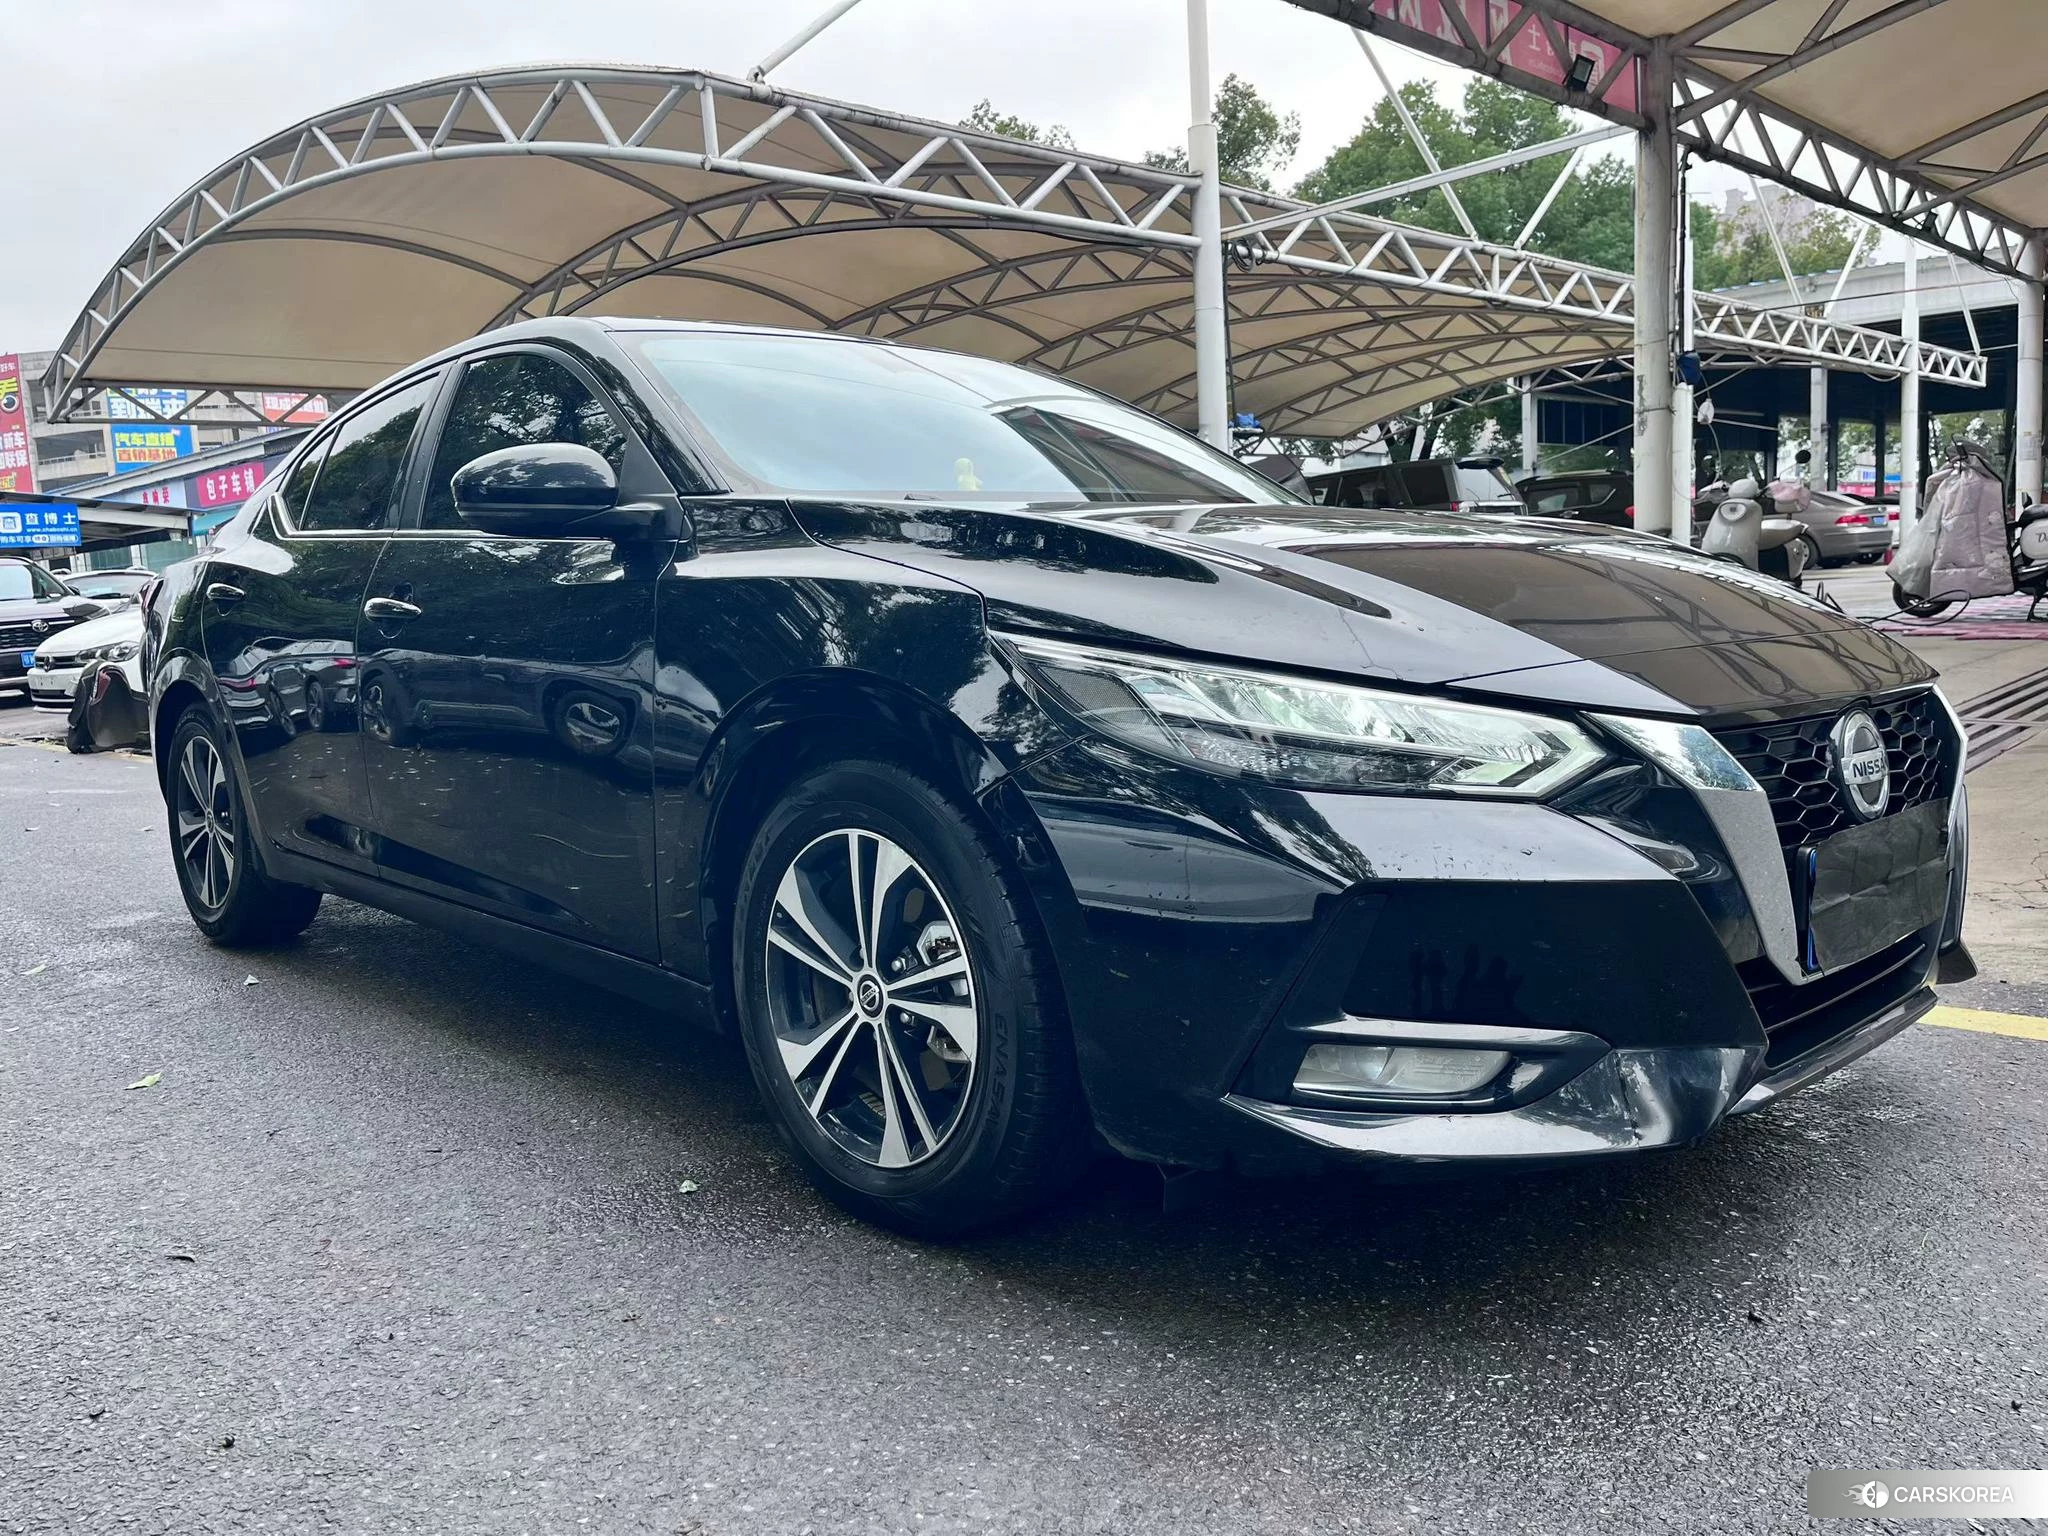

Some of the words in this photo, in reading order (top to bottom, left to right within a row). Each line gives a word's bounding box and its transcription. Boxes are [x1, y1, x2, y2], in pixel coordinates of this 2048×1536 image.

[0, 431, 26, 450] 新车
[24, 512, 77, 526] 查博士
